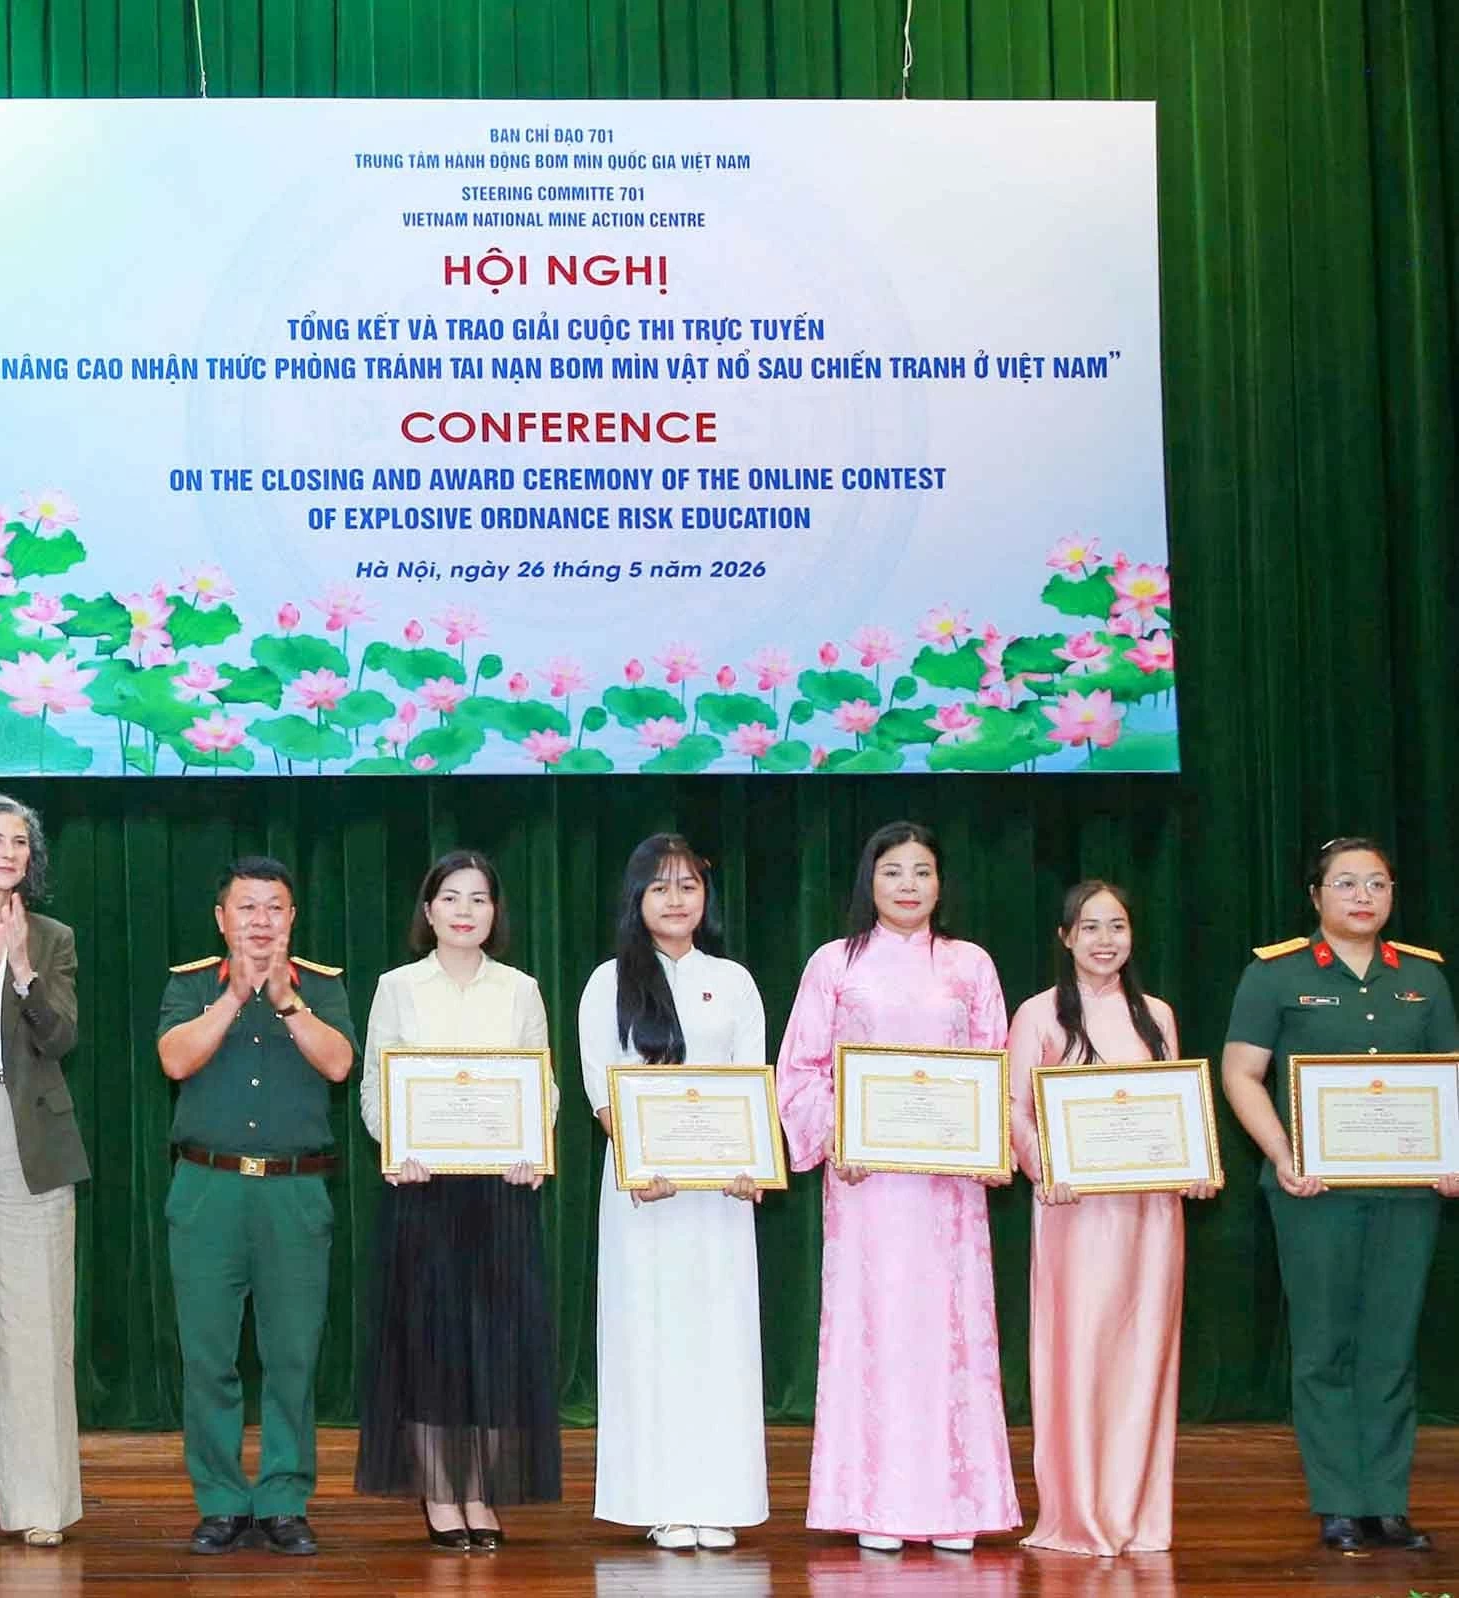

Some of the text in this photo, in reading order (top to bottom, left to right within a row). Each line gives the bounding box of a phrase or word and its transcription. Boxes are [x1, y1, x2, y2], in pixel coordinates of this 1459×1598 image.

[489, 127, 521, 144] BAN
[553, 127, 584, 147] ĐẠO
[587, 128, 614, 144] 701
[354, 150, 751, 173] TRUNG TÂM HÀNH ĐỘNG BOM MÌN QUỐC GIA VIỆT NAM
[461, 185, 645, 202] STEERING COMMITTE 701
[402, 211, 706, 228] VIETNAM NATIONAL MINE ACTION CENTRE
[444, 247, 668, 296] HỘI NGHỊ
[286, 309, 825, 346] TỔNG KẾT VÀ TRAO GIẢI CUỘC THI TRỰC TUYẾN
[76, 357, 124, 381] CAO
[131, 352, 199, 385] NHẬN
[205, 352, 267, 381] THỨC
[274, 351, 357, 380] PHÒNG
[363, 352, 443, 380] TRÁNH
[449, 356, 484, 380] TAI
[491, 356, 542, 385] NẠN
[549, 356, 604, 380] BOM
[611, 352, 659, 380] MÌN
[665, 352, 710, 385] VẬT
[717, 348, 751, 380] NỔ
[757, 356, 803, 380] SAU
[810, 349, 882, 380] CHIẾN
[888, 356, 966, 380] TRANH
[973, 348, 990, 380] Ở
[995, 351, 1046, 384] VIỆT
[400, 411, 717, 444] CONFERENCE
[169, 466, 947, 492] ON THE CLOSING AND AWARD CEREMONY OF THE ONLINE CONTEST
[308, 506, 811, 531] OF EXPLOSIVE ORDNANCE RISK EDUCATION
[355, 559, 767, 584] Hà Nội, ngày 26 tháng 5 năm 2026
